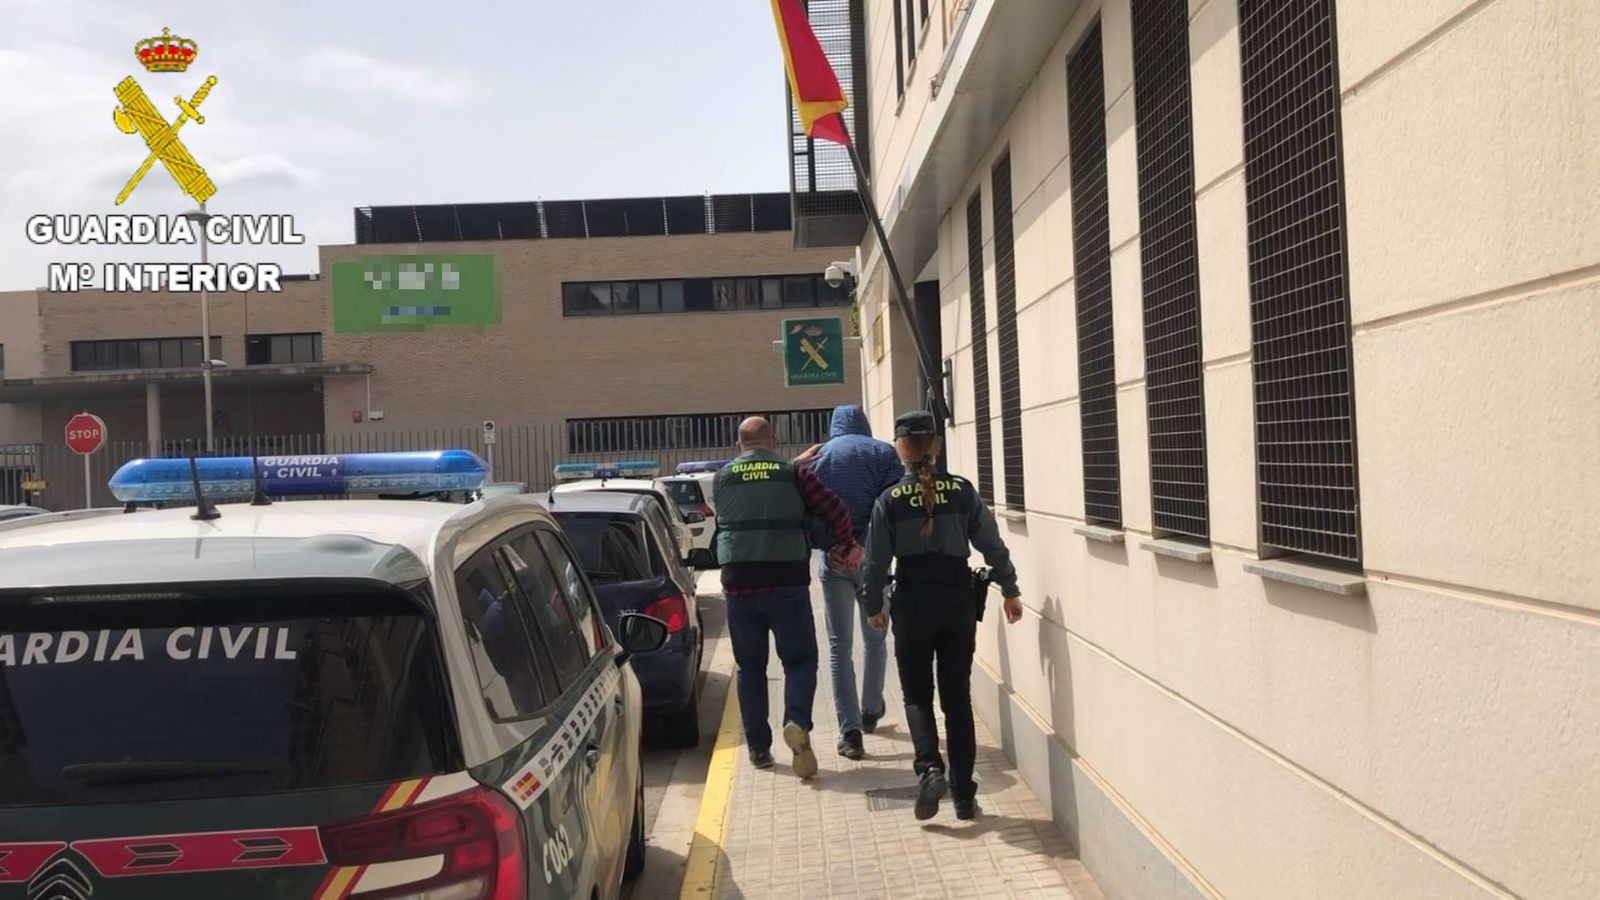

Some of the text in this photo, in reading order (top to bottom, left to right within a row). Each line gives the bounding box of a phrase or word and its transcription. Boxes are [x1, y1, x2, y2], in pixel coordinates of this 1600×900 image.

[69, 429, 100, 440] STOP
[263, 456, 339, 467] GUARDIA
[276, 467, 322, 479] CIVIL
[731, 462, 780, 474] GUARDIA
[742, 471, 770, 482] CIVIL
[890, 480, 962, 498] GUADIA
[909, 493, 948, 507] CIIL
[166, 626, 297, 661] CIVIL
